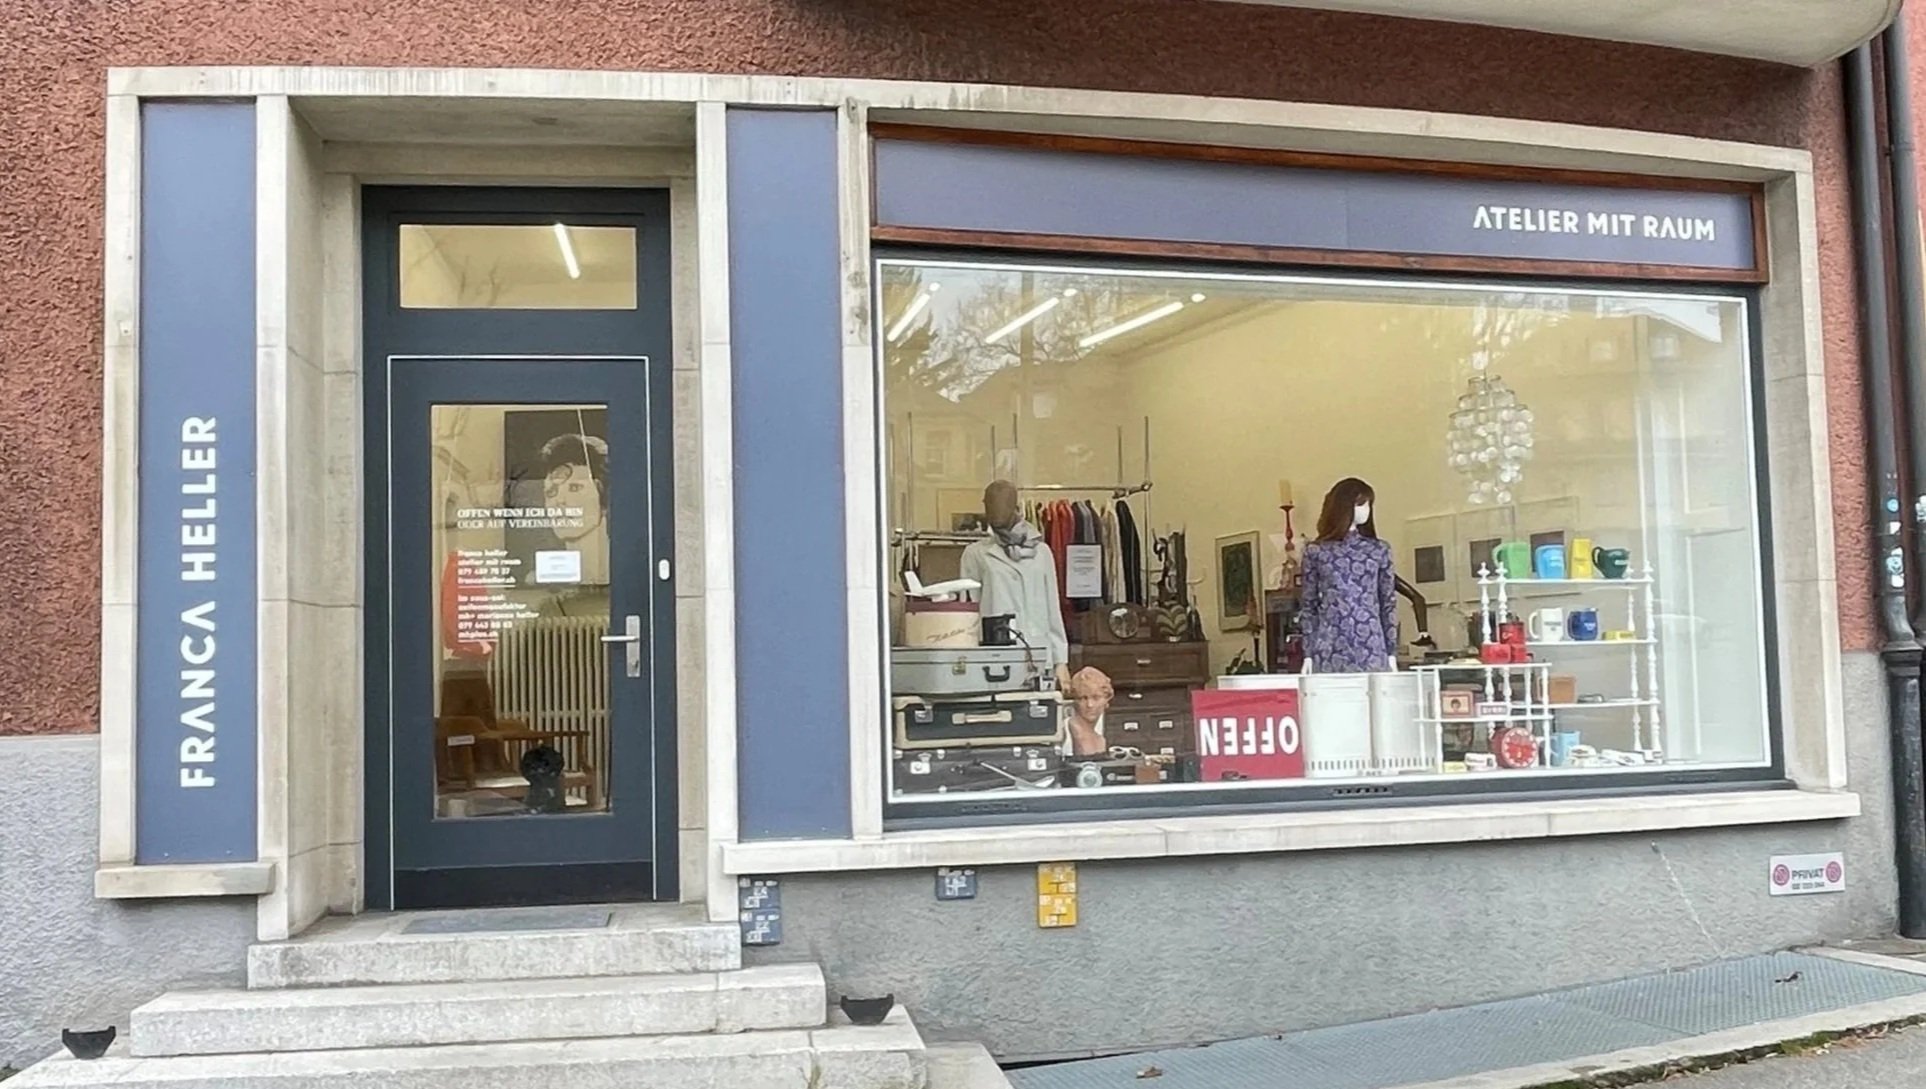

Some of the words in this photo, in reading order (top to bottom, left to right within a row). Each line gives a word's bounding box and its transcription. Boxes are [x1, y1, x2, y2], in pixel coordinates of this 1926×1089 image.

[1473, 206, 1579, 233] ATELIER
[1587, 212, 1636, 236] MIT
[1643, 215, 1715, 241] RAUM
[181, 416, 216, 580] HELLER
[457, 508, 490, 518] OFFEN
[493, 507, 523, 518] WENN
[525, 507, 545, 517] ICH
[547, 507, 563, 517] DA
[508, 517, 584, 528] VEREINBARUNG
[180, 600, 216, 787] FRANCA
[1791, 868, 1824, 880] PRIVAT
